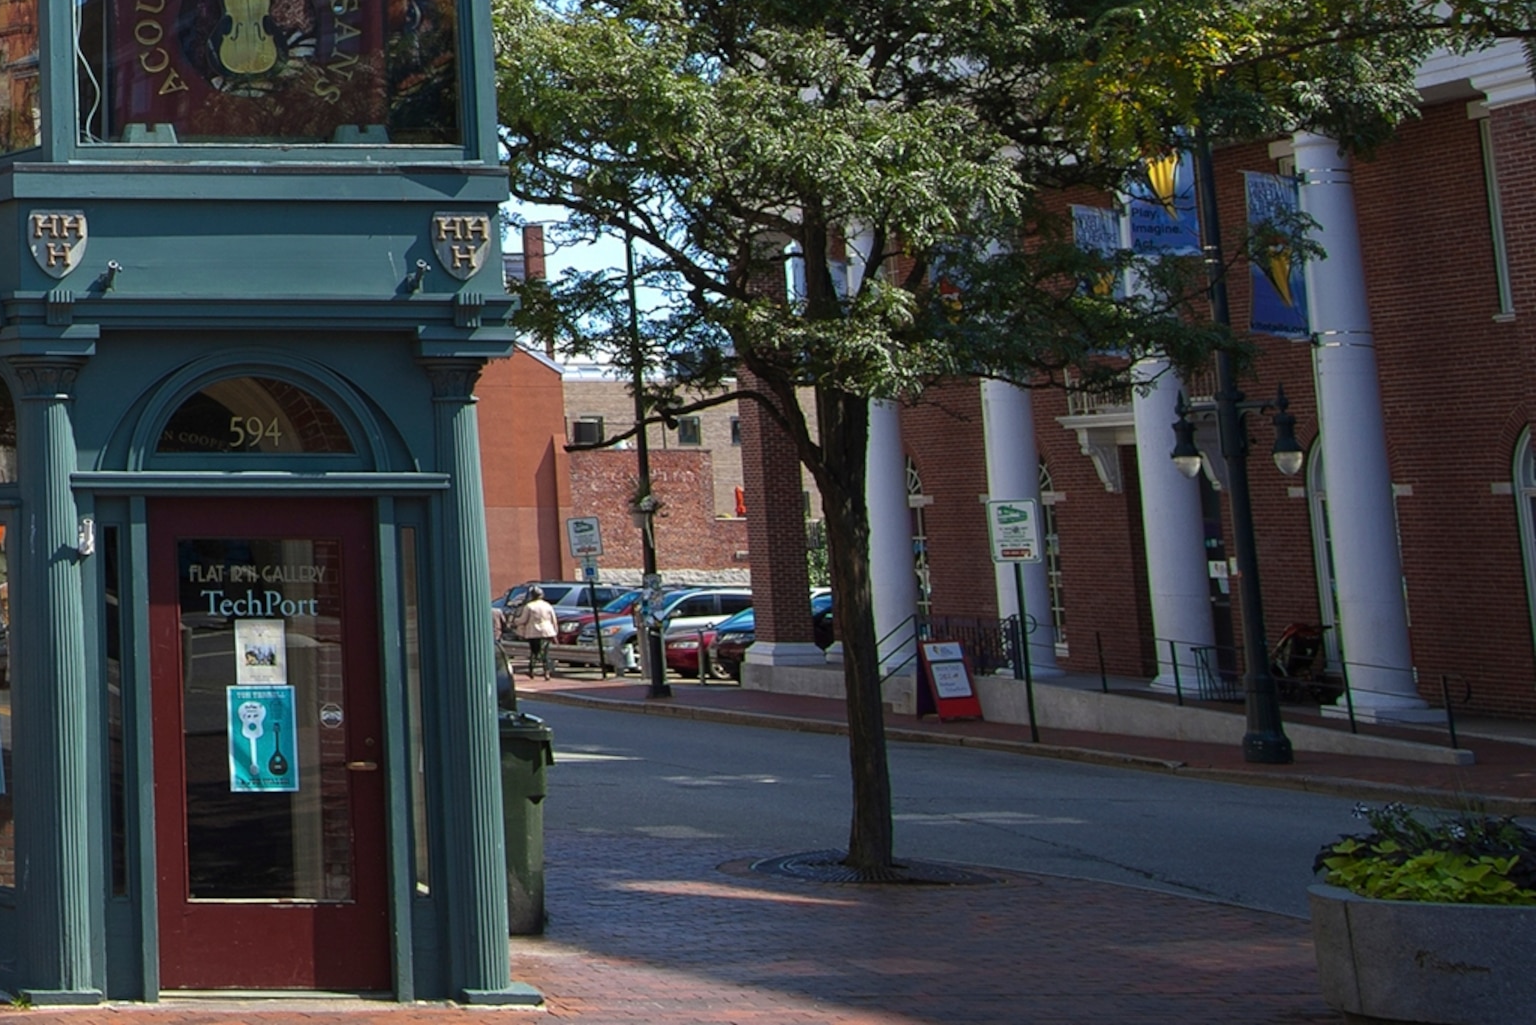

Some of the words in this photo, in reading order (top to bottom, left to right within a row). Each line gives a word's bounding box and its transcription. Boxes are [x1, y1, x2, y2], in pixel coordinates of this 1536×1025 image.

[1131, 223, 1184, 236] Imagine.
[229, 416, 282, 447] 594
[188, 564, 224, 583] FLAT
[261, 564, 326, 583] GALLERY
[200, 589, 319, 616] TechPort
